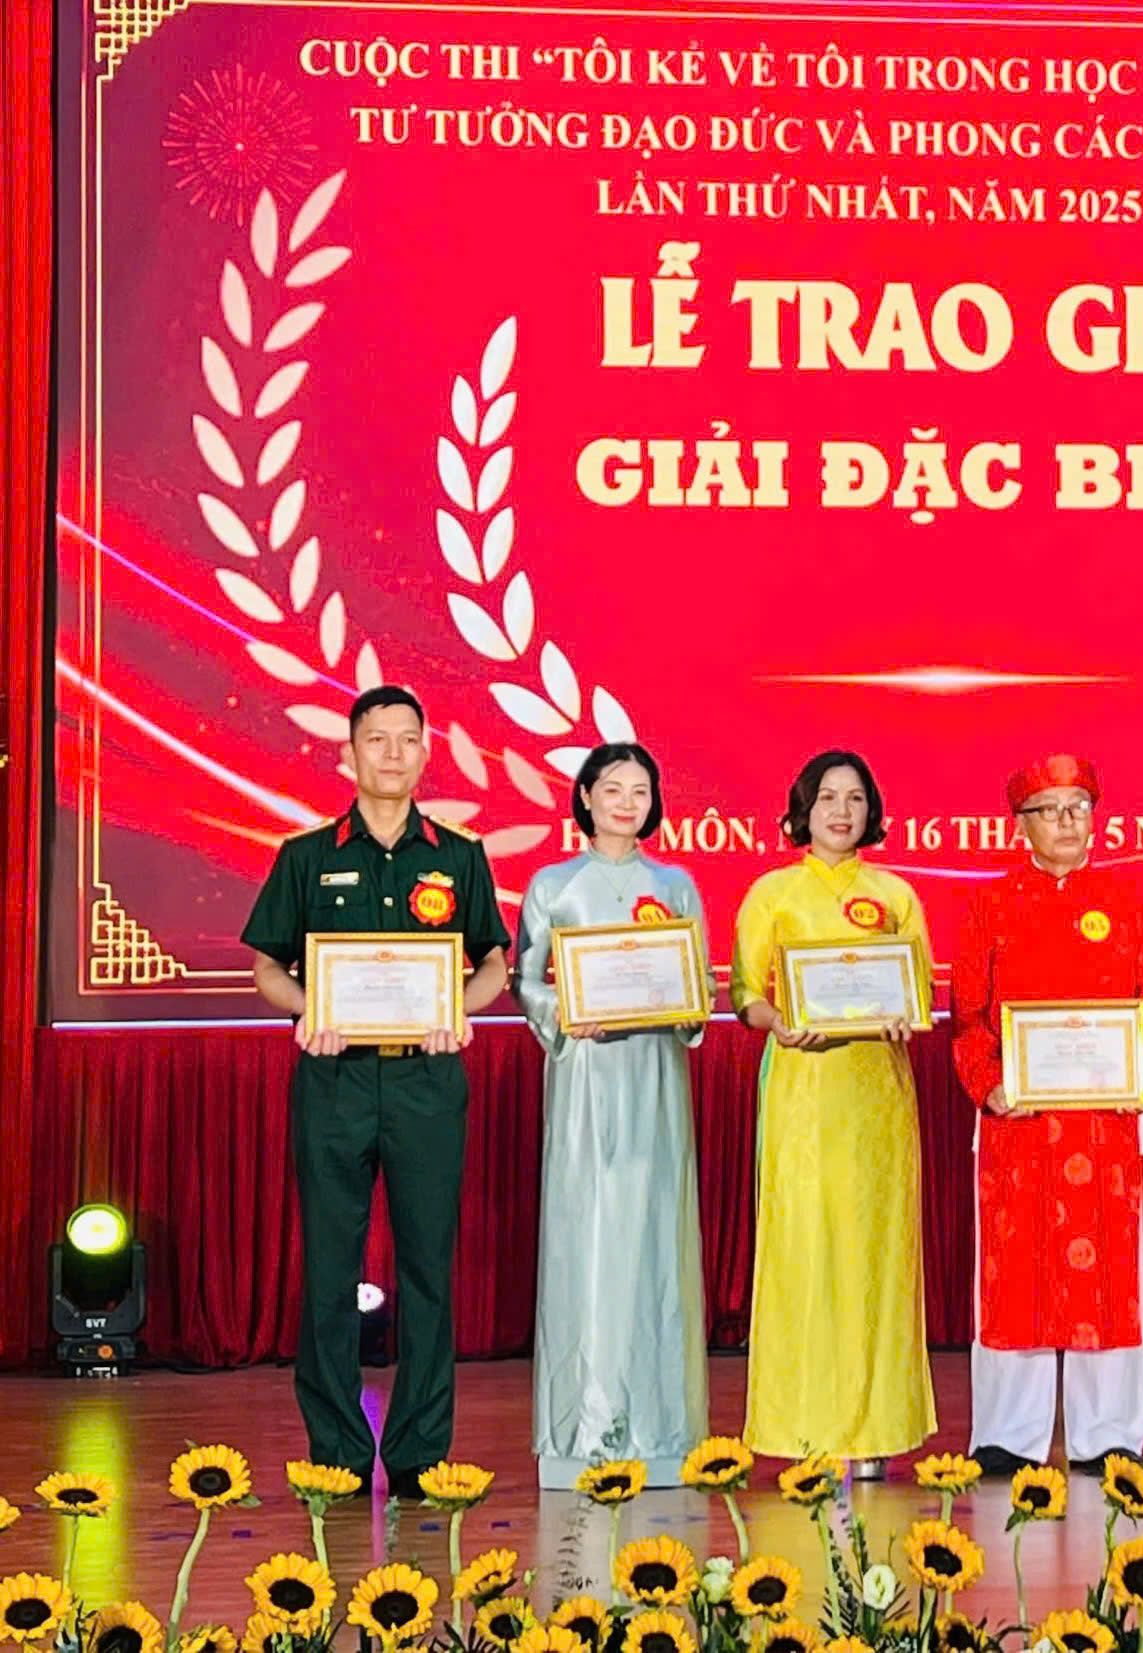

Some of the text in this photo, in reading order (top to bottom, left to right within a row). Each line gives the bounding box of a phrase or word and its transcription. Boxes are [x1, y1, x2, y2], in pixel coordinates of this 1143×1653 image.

[300, 37, 430, 87] CUỘC
[440, 44, 521, 80] THI
[787, 42, 865, 88] TÔI
[876, 55, 1030, 92] TRONG
[1044, 59, 1137, 103] HỌC
[351, 103, 418, 144] TƯ
[425, 101, 589, 148] TƯỞNG
[601, 114, 697, 159] ĐẠO
[709, 107, 803, 153] ĐỨC
[815, 109, 875, 154] VÀ
[890, 121, 1041, 158] PHONG
[697, 173, 796, 218] THỨ
[948, 179, 1045, 222] NĂM
[1059, 189, 1142, 223] 2025
[601, 241, 706, 368] LỄ
[731, 279, 1014, 373] TRAO
[575, 420, 789, 507] GIẢI
[821, 427, 1022, 525] ĐẶC
[659, 807, 766, 856] MÔN,
[905, 816, 942, 851] 16
[1105, 816, 1126, 850] 5
